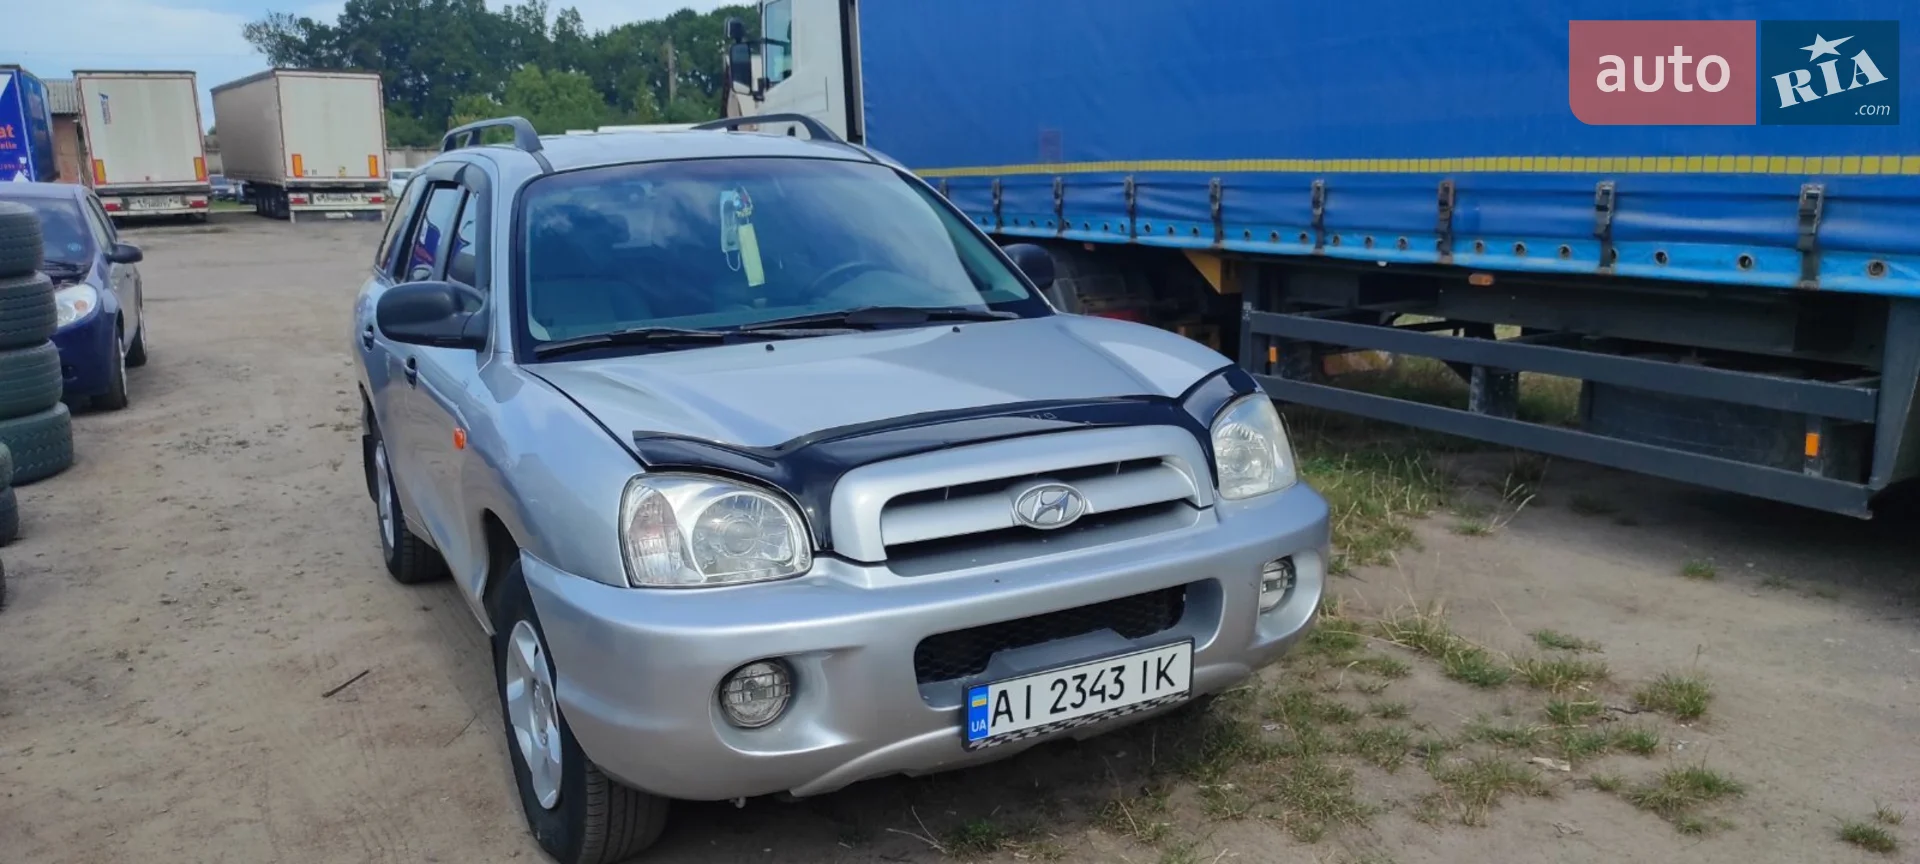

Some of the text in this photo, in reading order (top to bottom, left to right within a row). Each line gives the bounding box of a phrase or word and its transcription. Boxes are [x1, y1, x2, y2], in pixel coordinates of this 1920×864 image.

[991, 653, 1178, 727] AI 2343 IK
[971, 719, 987, 733] UA
